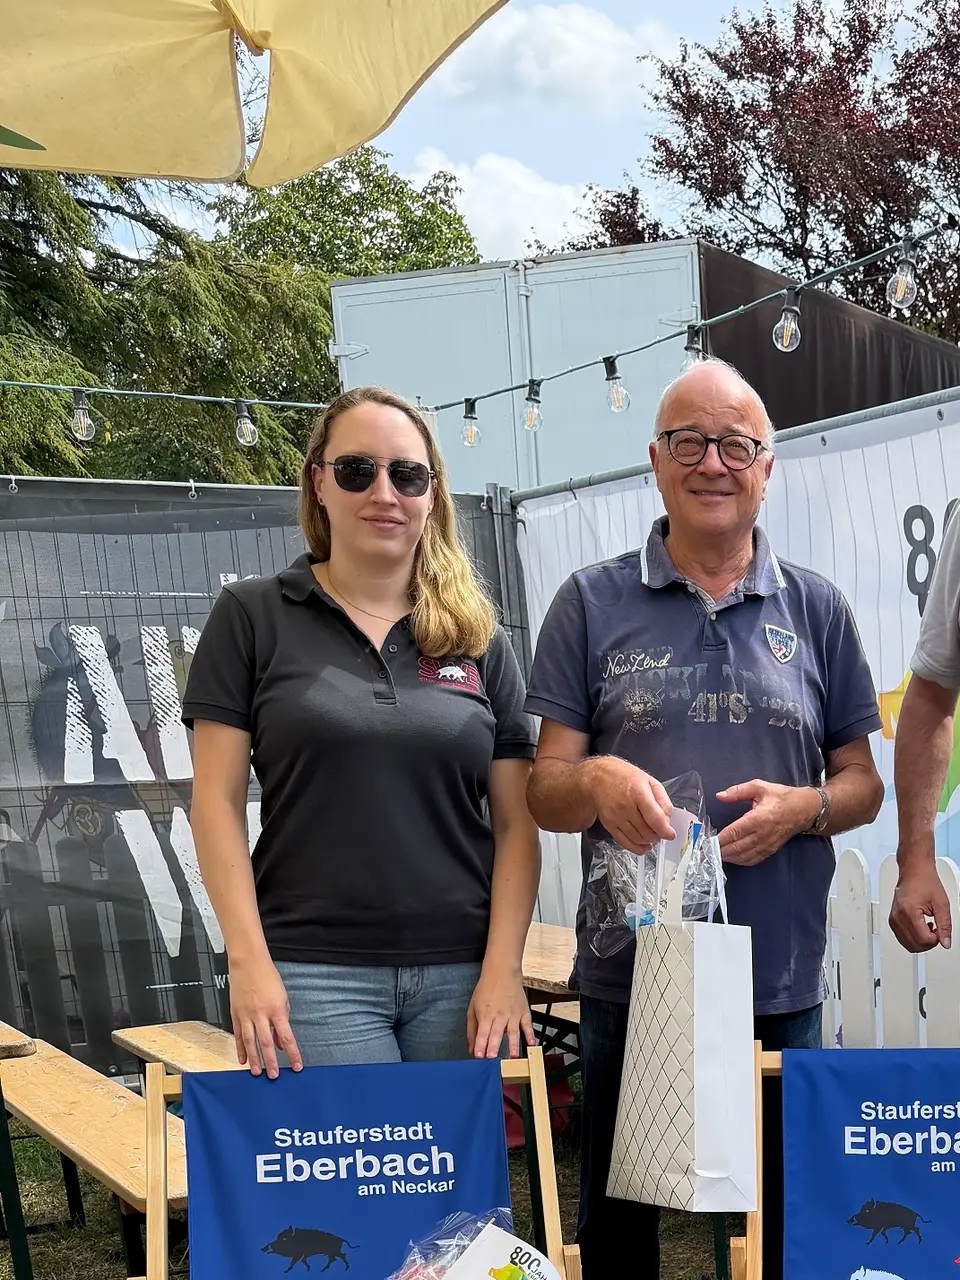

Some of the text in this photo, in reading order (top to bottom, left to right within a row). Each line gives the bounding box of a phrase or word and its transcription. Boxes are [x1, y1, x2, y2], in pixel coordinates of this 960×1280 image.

[274, 1121, 434, 1148] Stauferstadt
[255, 1145, 455, 1183] Eberbach
[931, 1161, 956, 1172] am
[357, 1179, 455, 1196] am Neckar
[509, 1246, 541, 1270] 800
